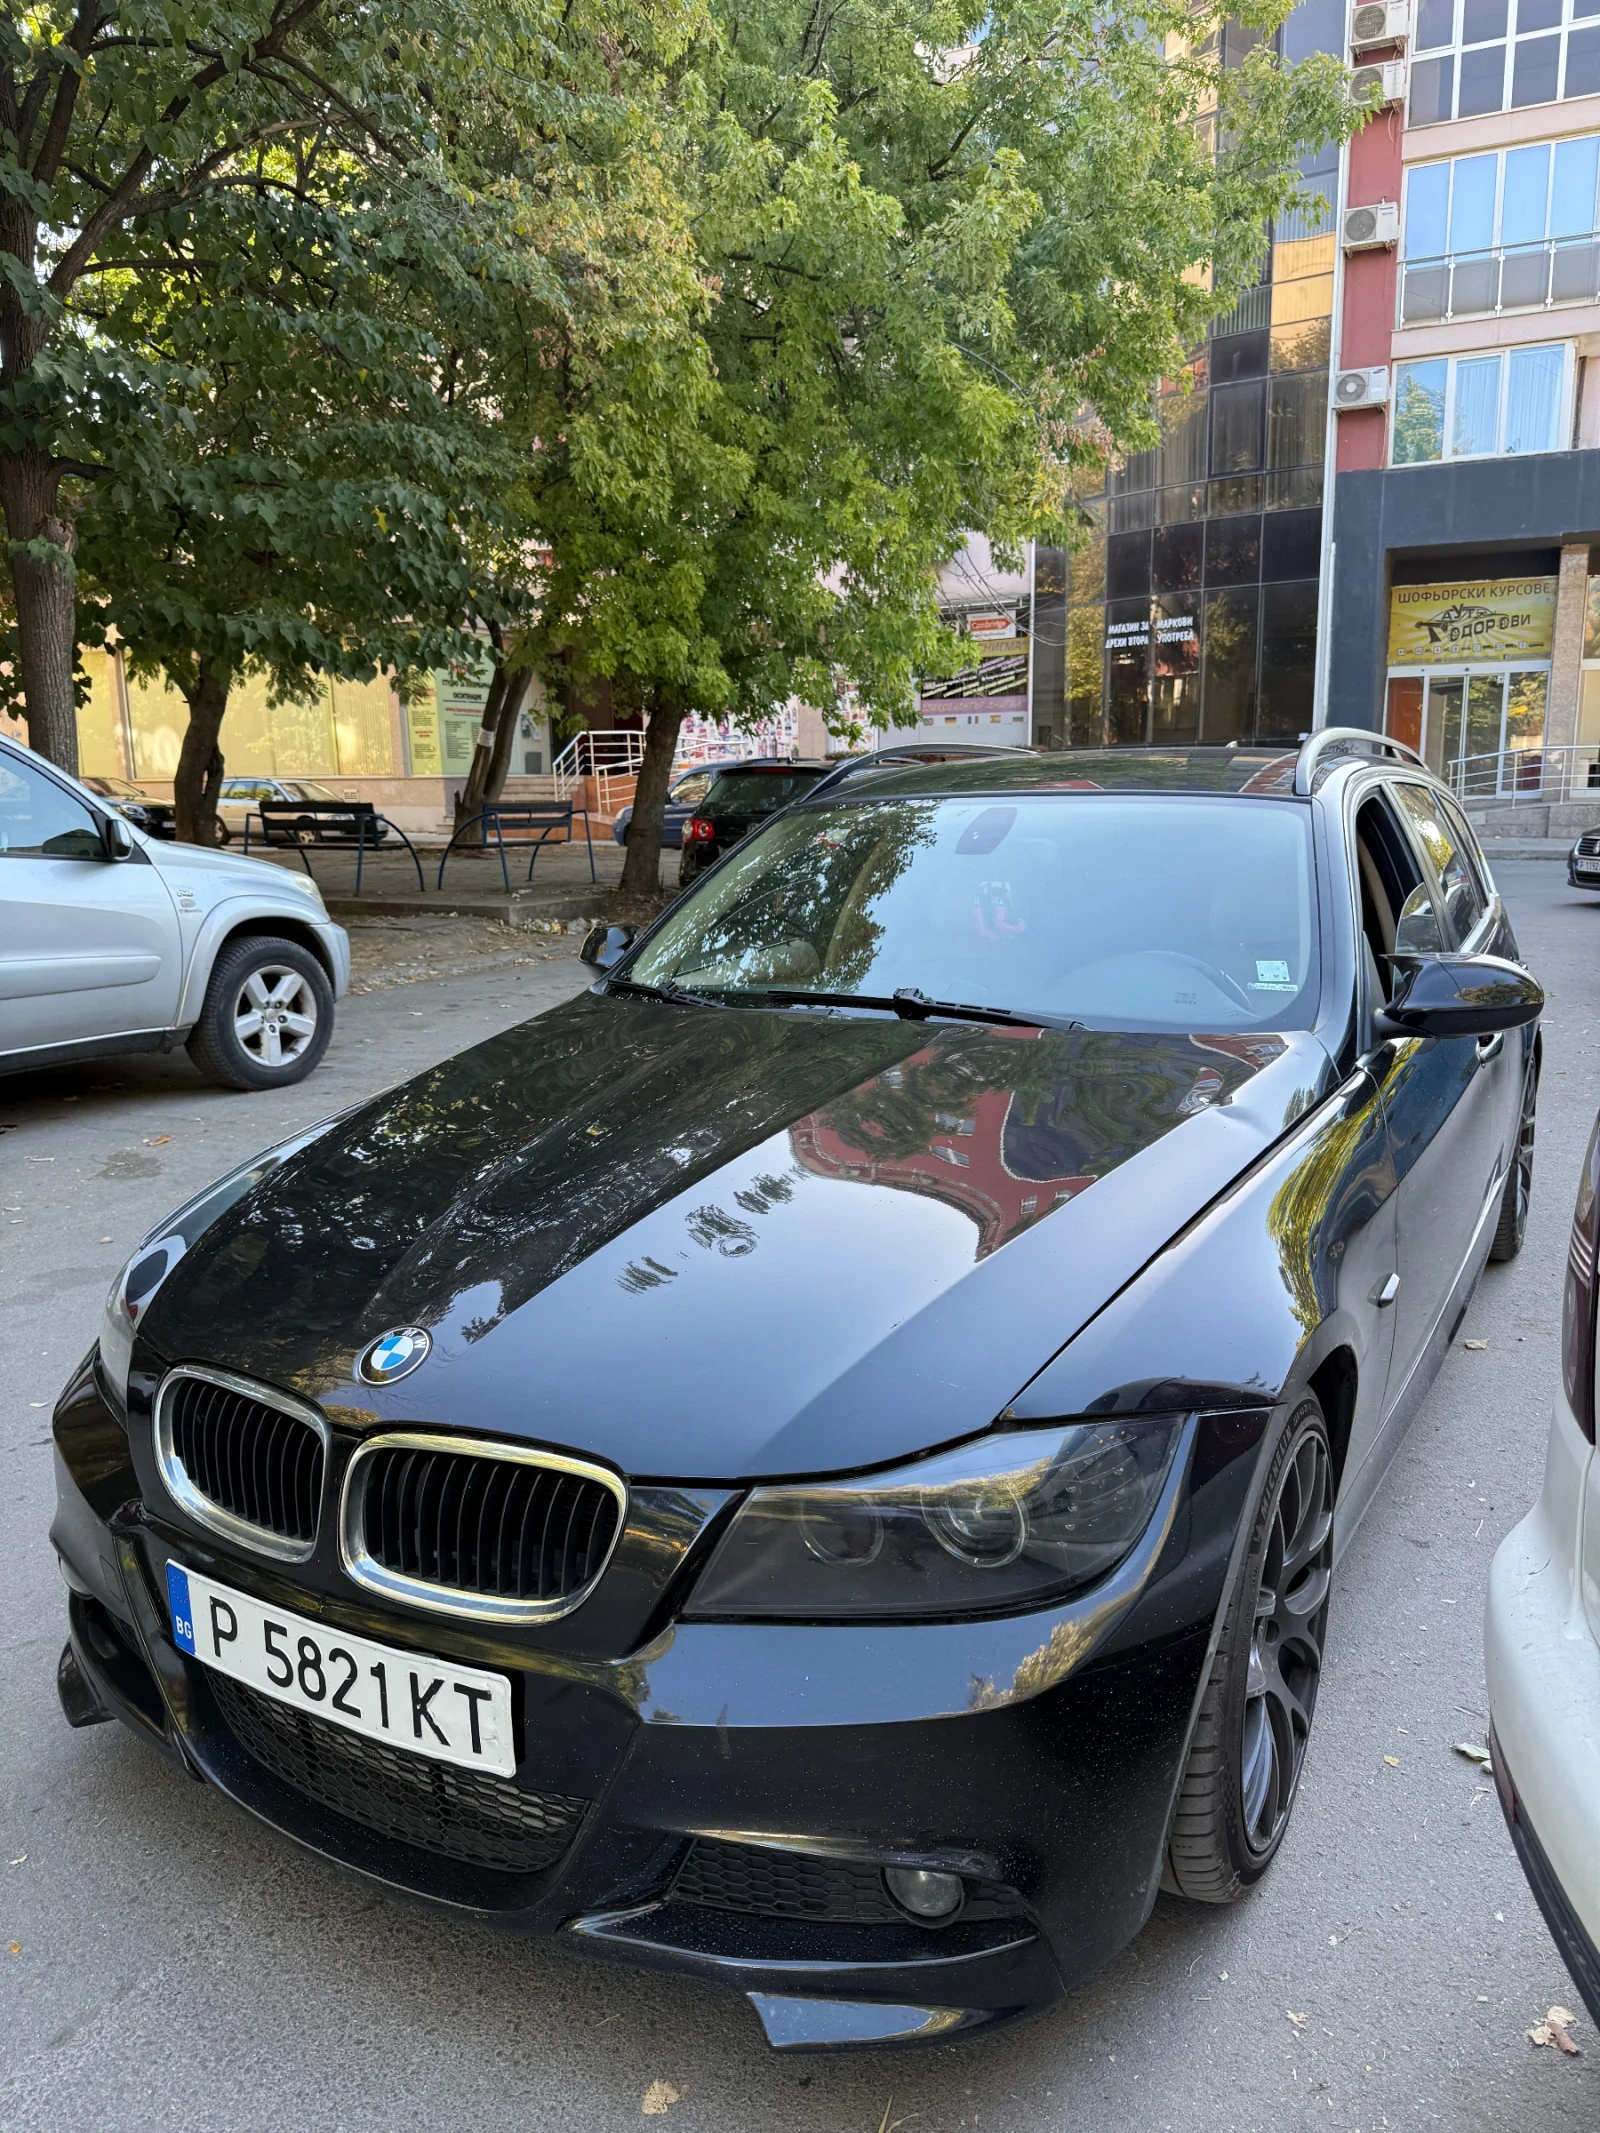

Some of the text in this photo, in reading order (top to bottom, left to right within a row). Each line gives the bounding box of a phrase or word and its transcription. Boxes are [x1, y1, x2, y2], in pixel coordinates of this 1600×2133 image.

[1398, 582, 1550, 604] ШОФЬОРСКИ КУРСОВЕ
[1108, 616, 1194, 634] МАГАЗИН ЗА МАРКОВИ
[1105, 630, 1194, 649] ДРЕХИ ВТОРА УПОТРЕБА
[383, 1328, 427, 1349] BMW
[1260, 1425, 1293, 1521] MICHELIN
[175, 1616, 193, 1640] BG
[210, 1595, 492, 1755] P 5821 KT
